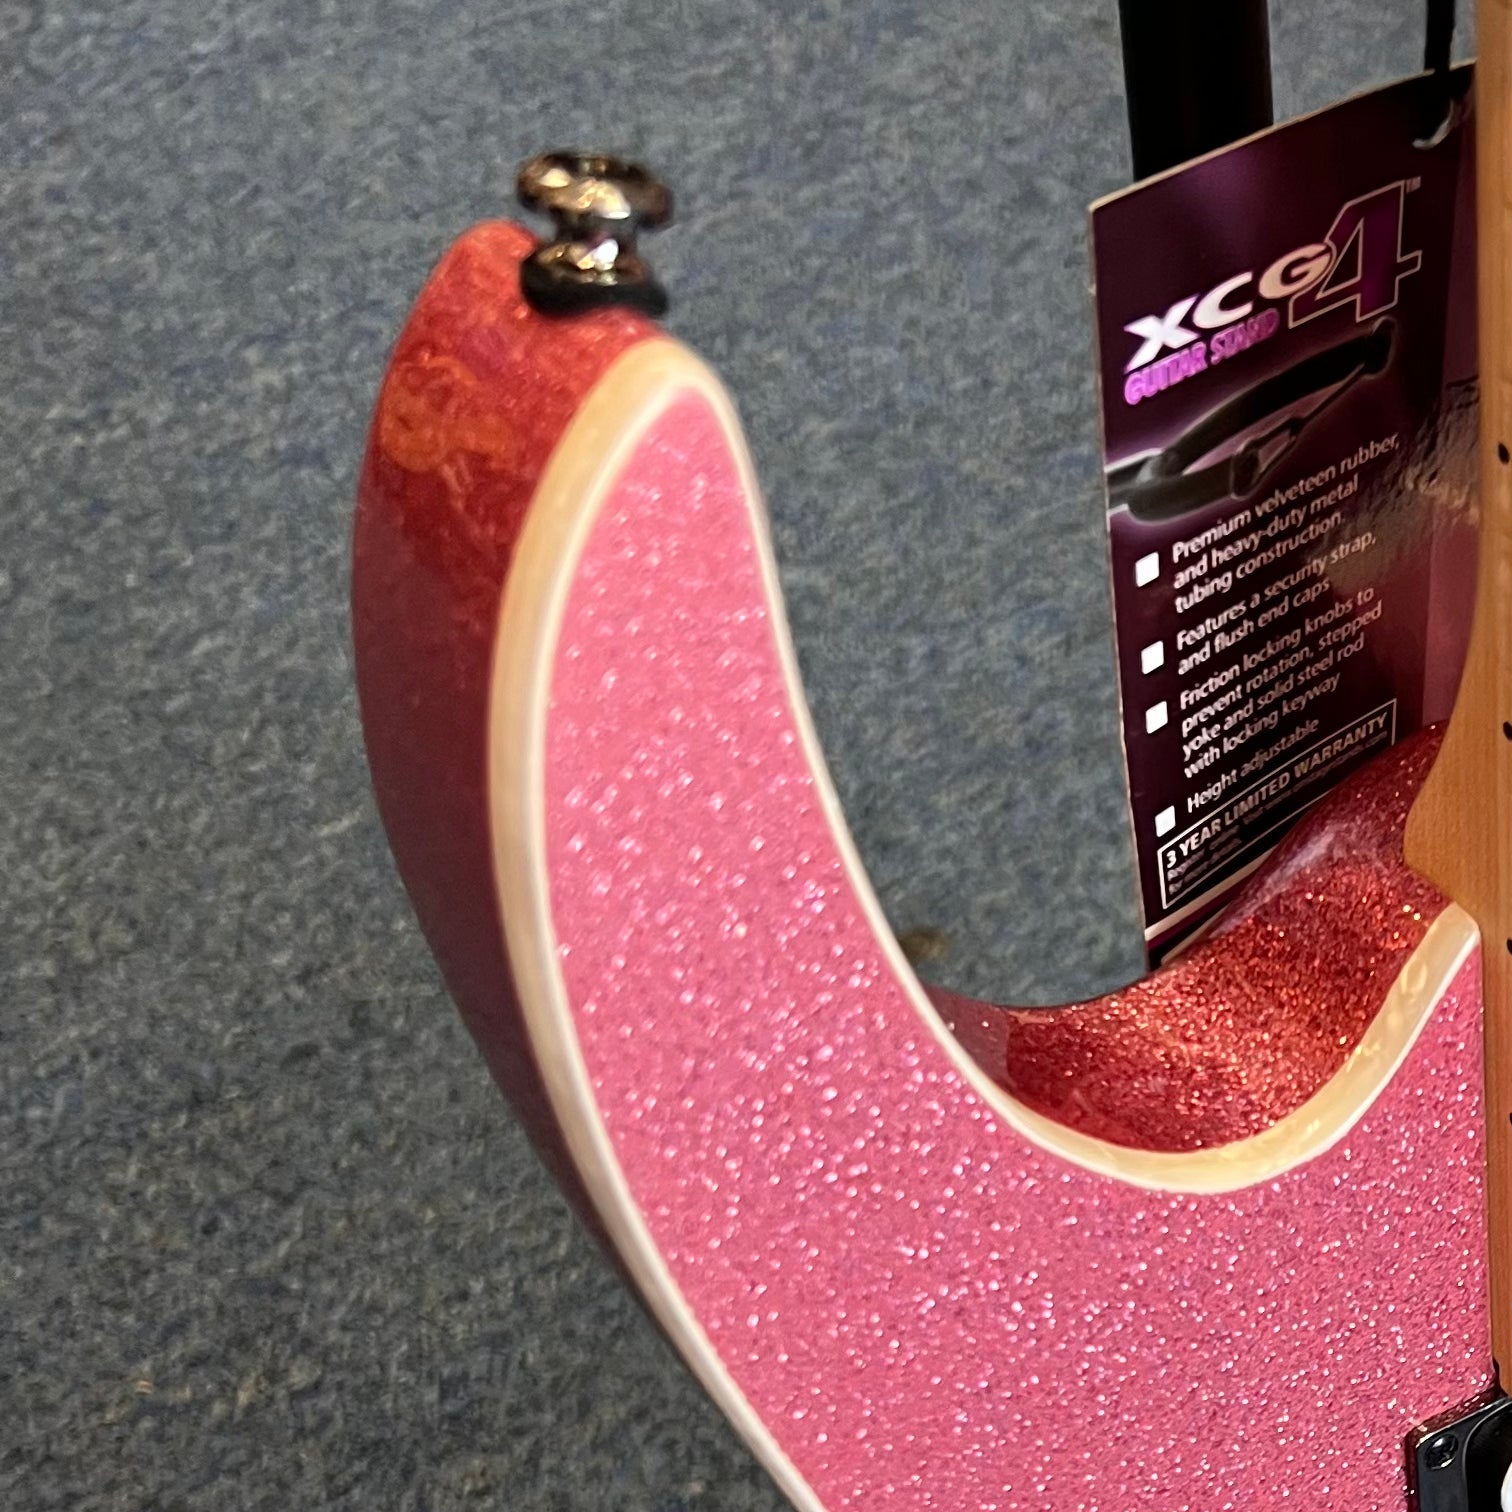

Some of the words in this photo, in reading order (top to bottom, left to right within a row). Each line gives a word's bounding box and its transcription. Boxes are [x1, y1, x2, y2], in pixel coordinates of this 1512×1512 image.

[1172, 509, 1251, 563] Premium
[1255, 466, 1336, 518] velveteen
[1340, 432, 1400, 477] rubber,
[1174, 556, 1208, 589] and
[1212, 507, 1306, 566] heavy-duty
[1310, 476, 1359, 517] metal
[1175, 571, 1233, 614] tubing
[1176, 599, 1247, 650] Features
[1250, 593, 1259, 608] a
[1264, 553, 1328, 600] security
[1330, 531, 1377, 564] strap,
[1178, 644, 1211, 675] and
[1214, 618, 1254, 654] flush
[1258, 599, 1289, 628] end
[1292, 578, 1330, 614] caps
[1180, 666, 1240, 711] Friction
[1242, 627, 1301, 670] locking
[1305, 596, 1353, 634] knobs
[1357, 587, 1375, 608] to
[1181, 687, 1243, 738] prevent
[1319, 600, 1383, 650] stepped
[1183, 722, 1221, 762] yoke
[1223, 697, 1253, 730] and
[1257, 678, 1294, 710] solid
[1297, 654, 1334, 691] steel
[1336, 634, 1365, 664] rod
[1184, 744, 1220, 778] with
[1223, 708, 1279, 753] locking
[1281, 672, 1341, 716] keyway
[1166, 850, 1177, 869] 3
[1179, 817, 1222, 857] YEAR
[1224, 771, 1291, 827] LIMITED
[1294, 711, 1387, 778] WARRANTY
[1187, 768, 1238, 813] Height
[1240, 717, 1319, 777] adjustable
